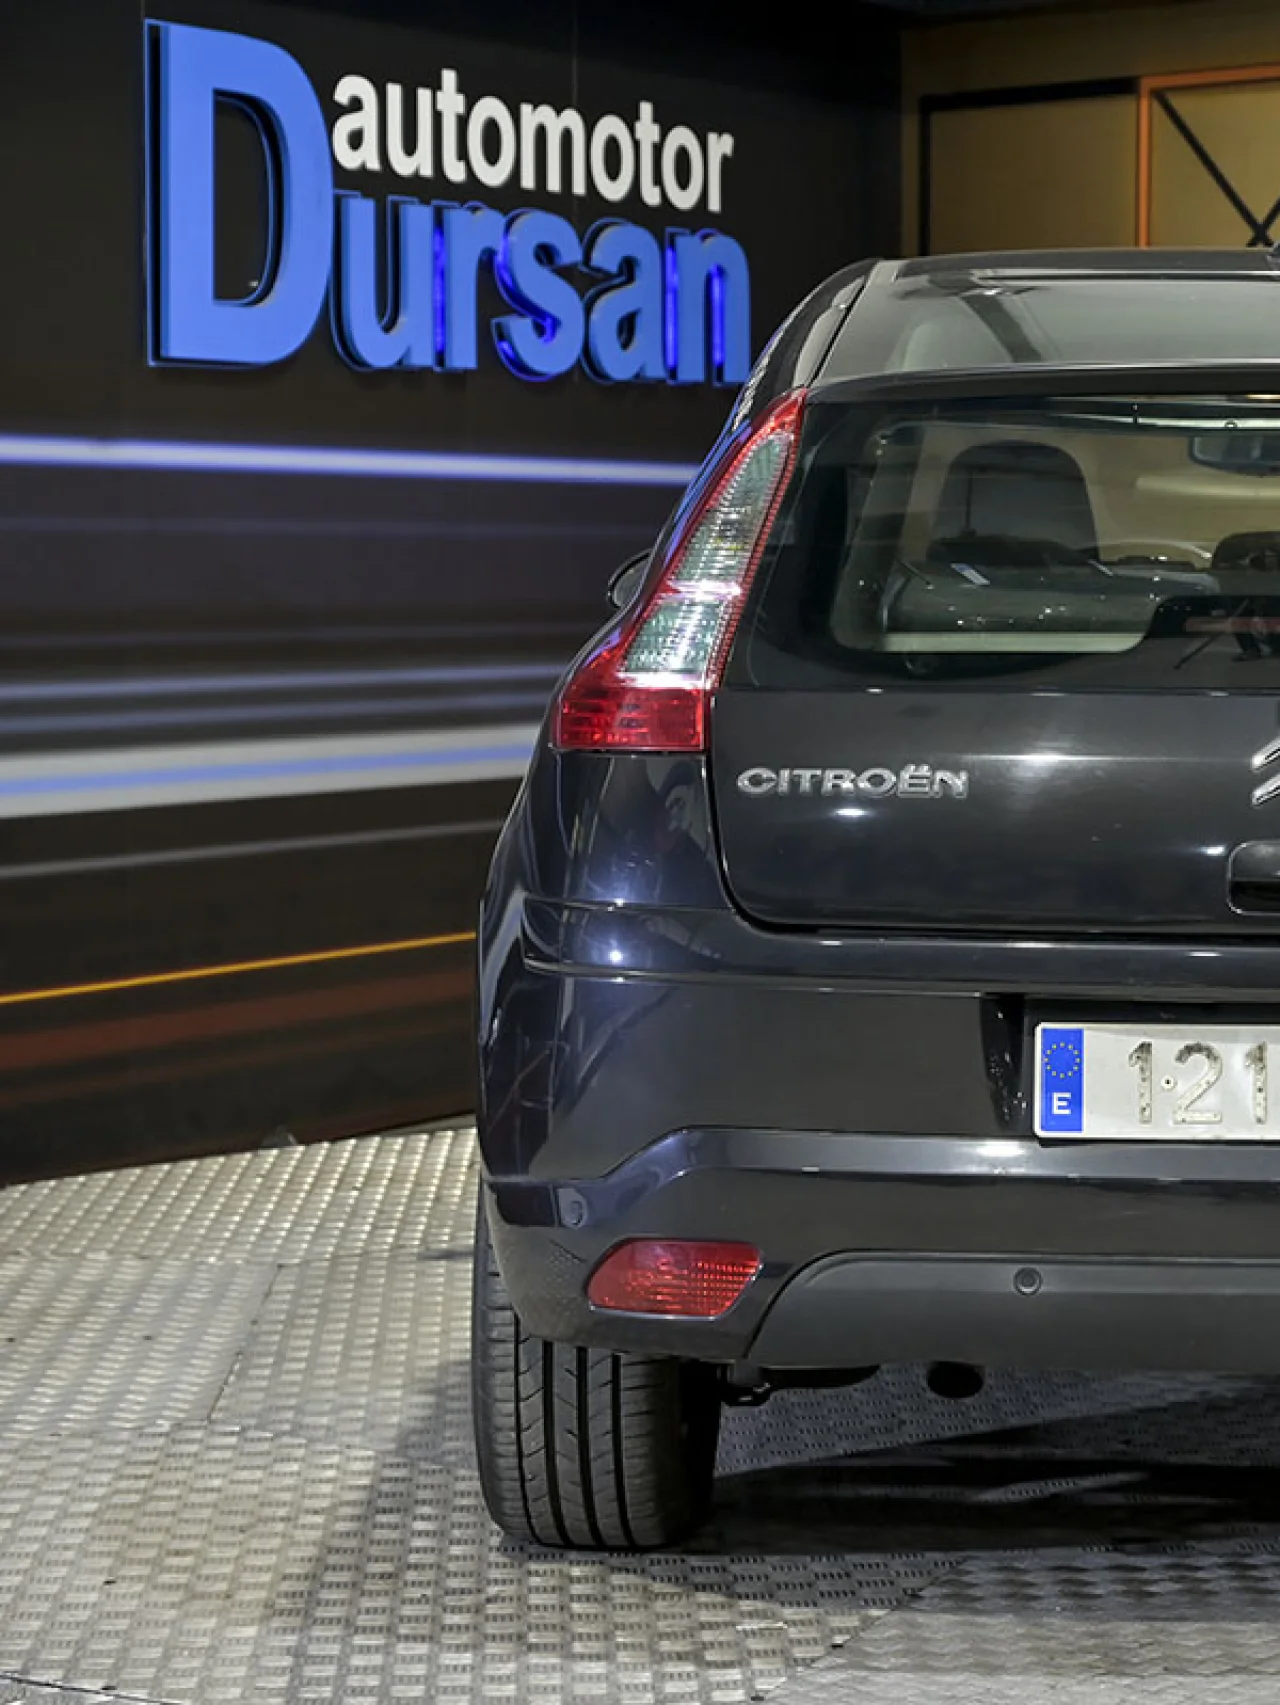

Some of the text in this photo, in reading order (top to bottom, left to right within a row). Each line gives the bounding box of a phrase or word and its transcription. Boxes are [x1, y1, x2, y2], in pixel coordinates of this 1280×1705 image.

[332, 69, 734, 212] automotor
[145, 19, 751, 385] Dursan
[737, 763, 969, 798] CITROËN
[1051, 1091, 1072, 1115] E
